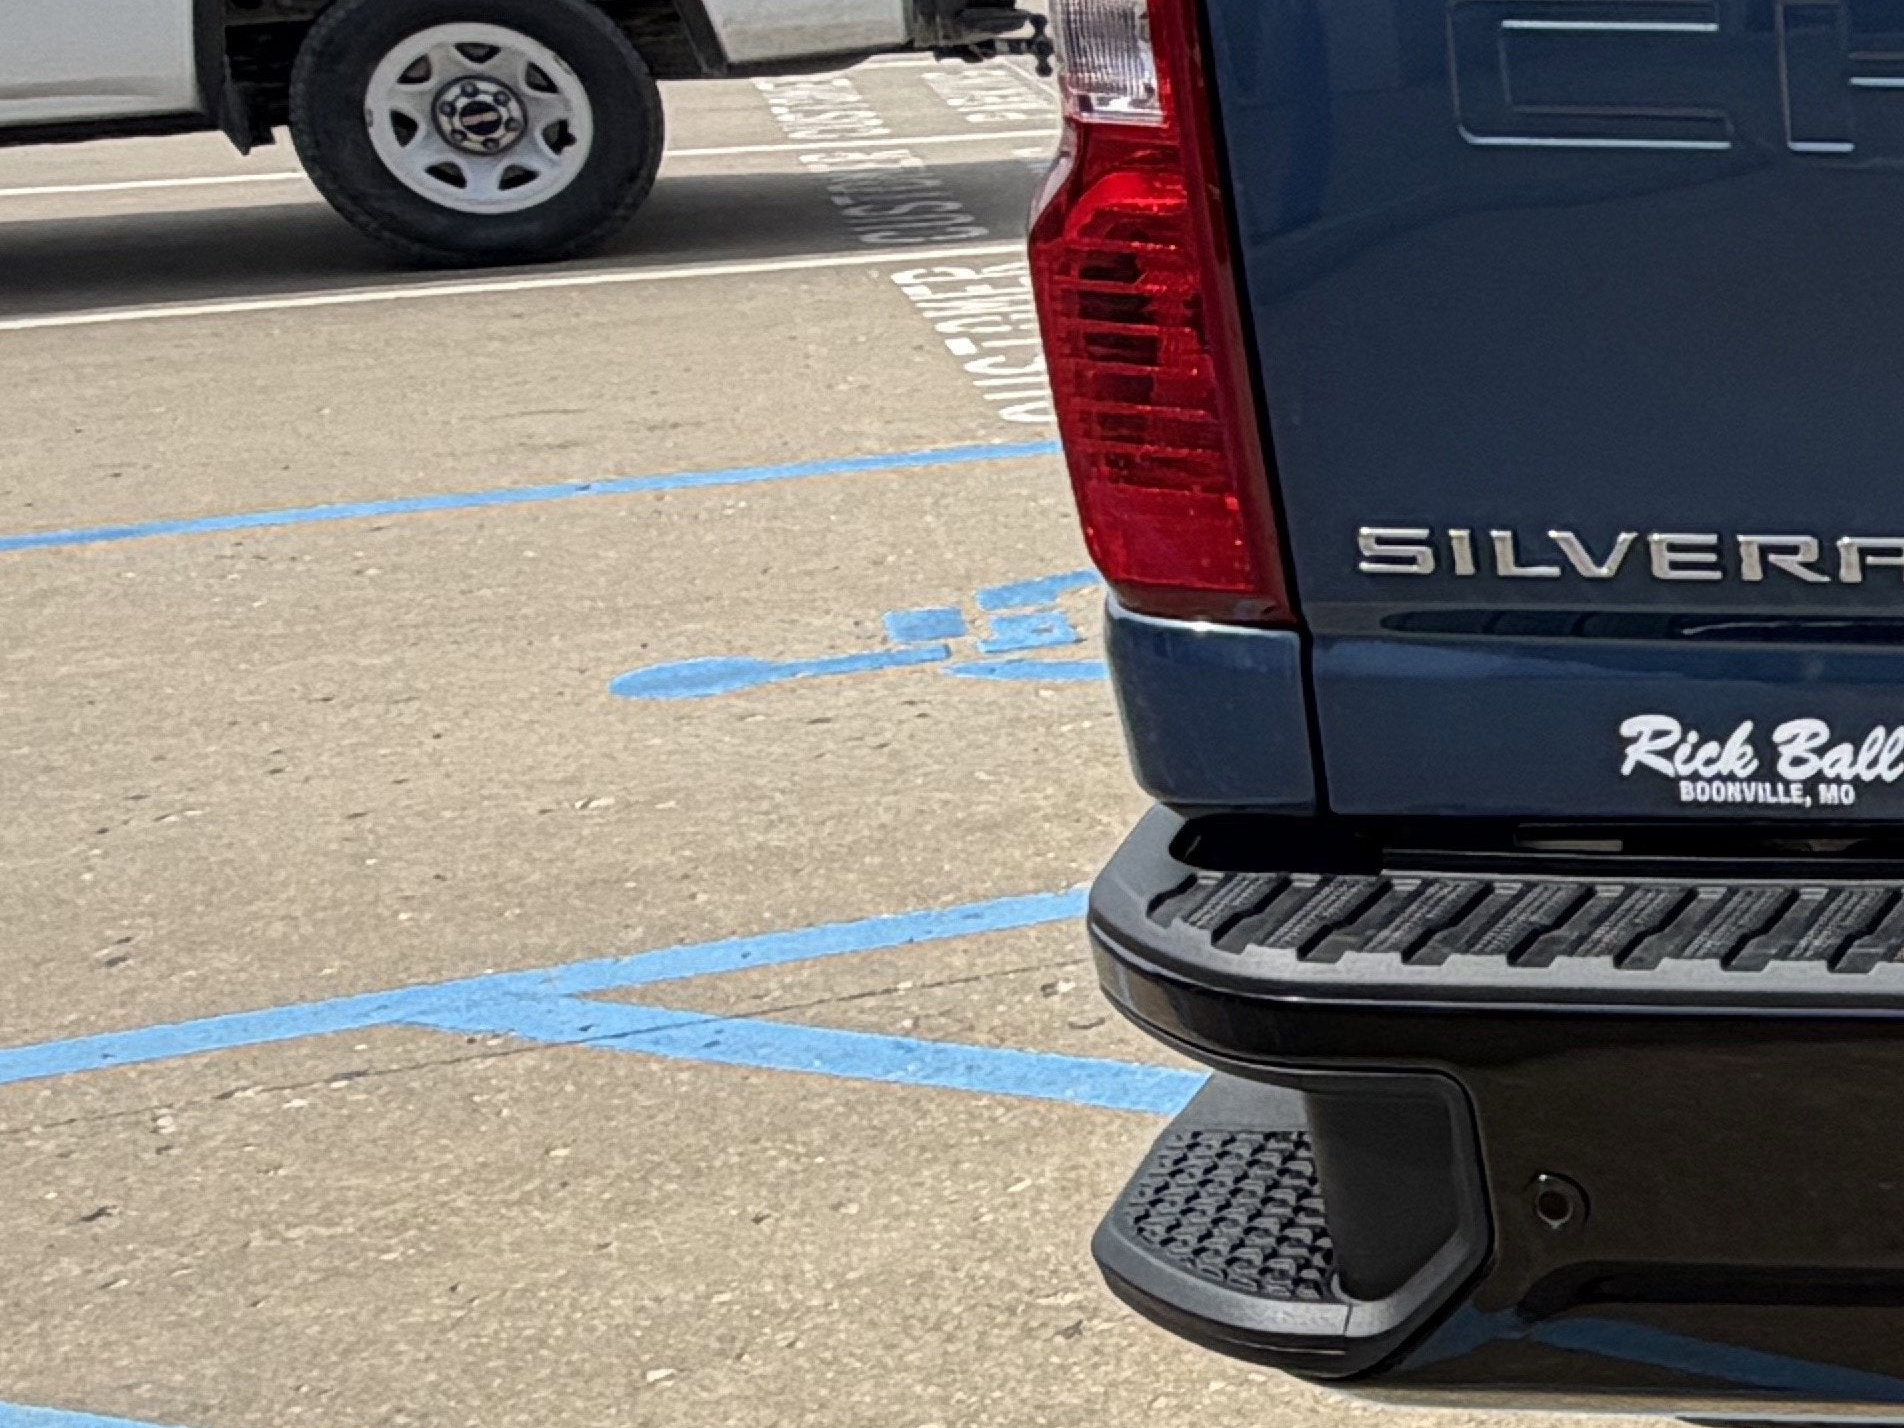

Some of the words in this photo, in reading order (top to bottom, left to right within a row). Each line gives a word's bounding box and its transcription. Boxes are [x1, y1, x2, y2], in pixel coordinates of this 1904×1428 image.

[1619, 714, 1760, 779] Rick
[1679, 779, 1812, 808] BOONVILLE,
[1818, 782, 1856, 806] MO
